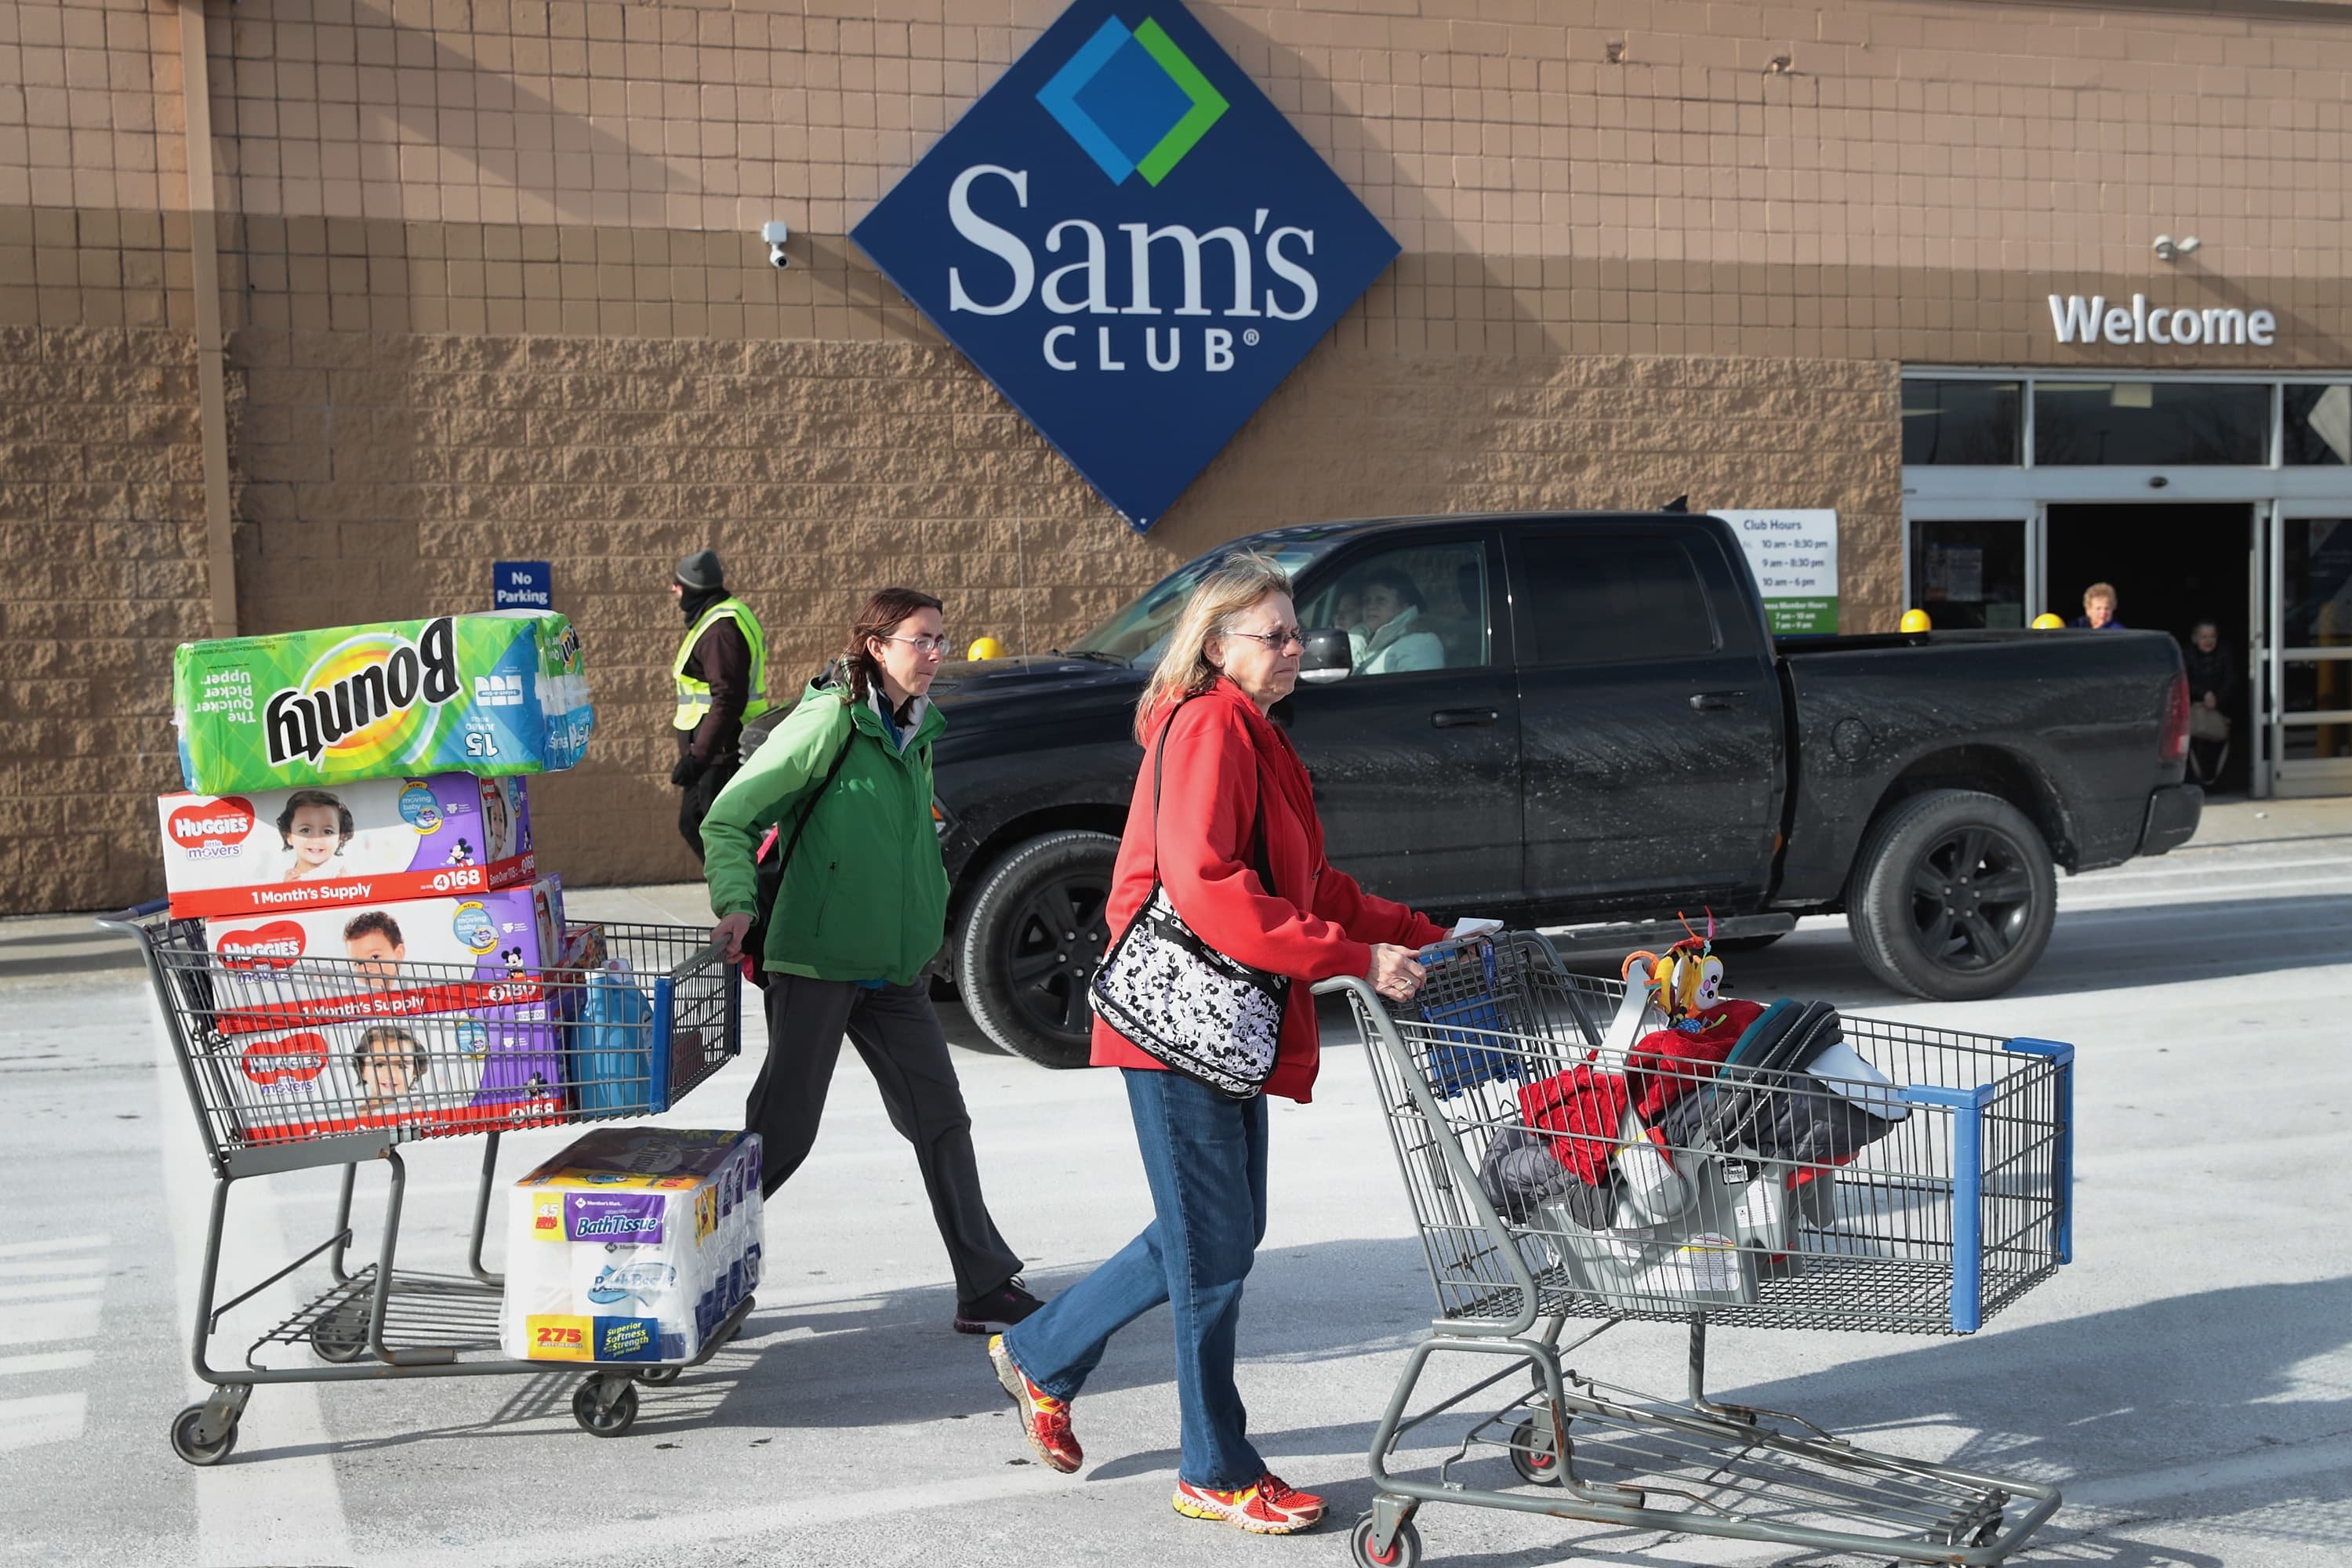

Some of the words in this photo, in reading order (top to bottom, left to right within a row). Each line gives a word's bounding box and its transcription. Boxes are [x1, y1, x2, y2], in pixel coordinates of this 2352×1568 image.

[947, 163, 1319, 321] Sam's
[2048, 293, 2275, 347] Welcome
[1744, 520, 1767, 531] Club
[1770, 520, 1802, 530] Hours
[1762, 539, 1772, 548] 10
[1794, 539, 1813, 548] 8:30
[1815, 541, 1828, 550] pm
[1762, 558, 1768, 567] 9
[1790, 558, 1809, 567] 8:30
[1811, 560, 1824, 568] pm
[511, 572, 532, 585] No
[1762, 578, 1773, 586] 10
[497, 589, 548, 604] Parking
[204, 685, 252, 698] Picker
[266, 617, 460, 764] Bounty
[194, 699, 254, 713] Quicker
[228, 711, 256, 724] The
[465, 732, 499, 757] 15
[189, 846, 240, 858] movers
[448, 869, 481, 887] 168
[252, 891, 259, 904] 1
[261, 887, 318, 904] Month's
[321, 883, 372, 900] Supply
[314, 1000, 371, 1016] Month's
[374, 996, 426, 1012] Supply
[539, 1203, 559, 1218] 45
[537, 1327, 582, 1343] 275
[607, 1322, 642, 1337] Superior
[605, 1330, 646, 1346] Softness
[613, 1336, 649, 1351] Strength
